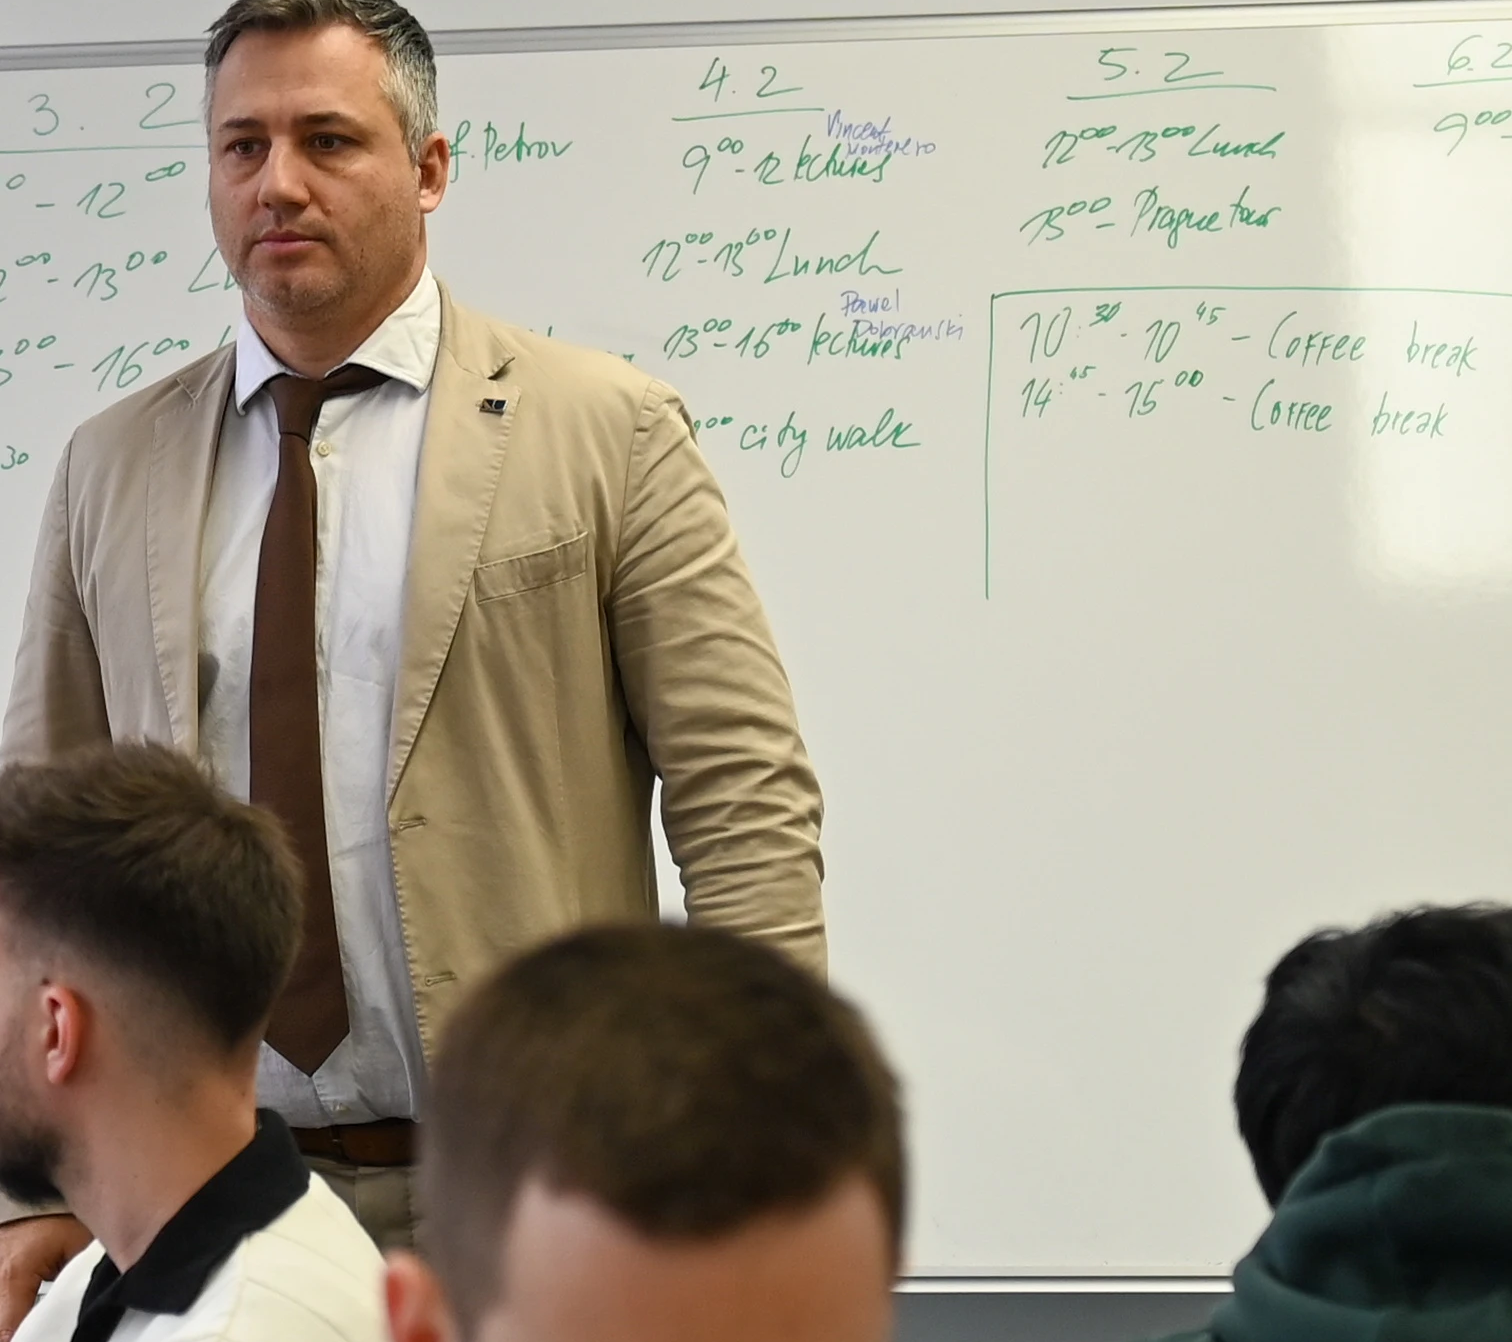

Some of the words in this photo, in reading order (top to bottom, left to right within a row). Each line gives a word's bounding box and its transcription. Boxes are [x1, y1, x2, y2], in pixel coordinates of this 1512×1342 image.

[482, 120, 574, 171] Petrov
[793, 133, 893, 184] lectures
[1187, 123, 1286, 159] Lunch
[1130, 185, 1223, 249] Prague
[763, 227, 904, 284] Lunch
[806, 311, 912, 366] lectures
[1406, 320, 1479, 377] break
[1370, 390, 1449, 439] break
[739, 410, 809, 479] city
[826, 407, 922, 453] walk
